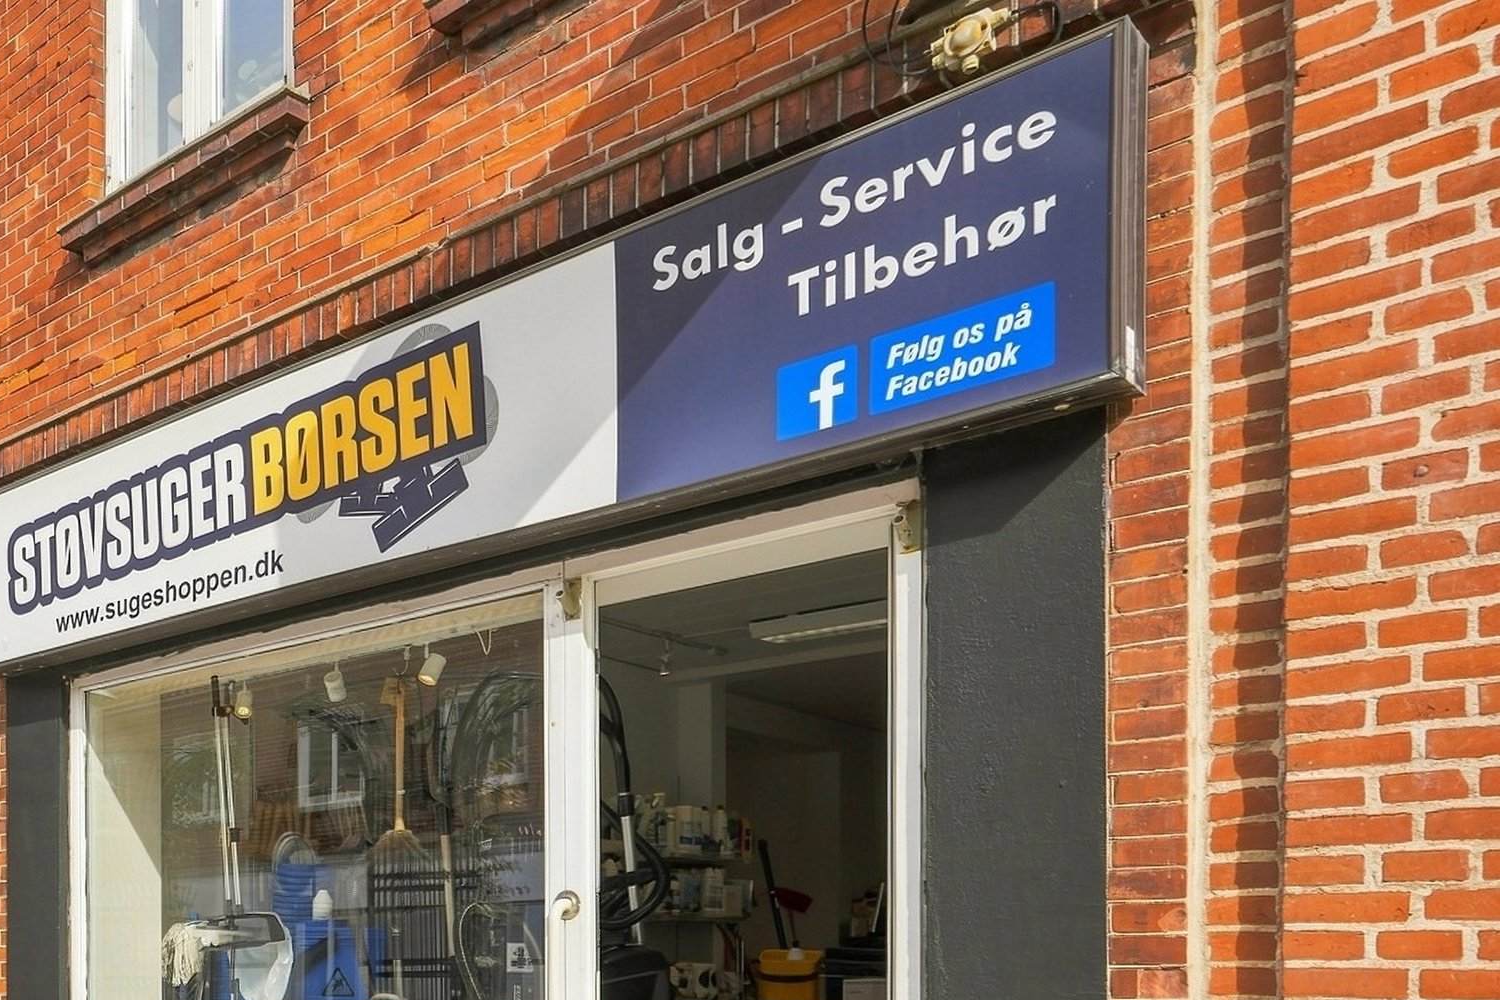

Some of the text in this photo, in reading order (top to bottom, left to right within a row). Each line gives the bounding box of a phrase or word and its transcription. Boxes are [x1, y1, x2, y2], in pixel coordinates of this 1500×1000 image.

[651, 221, 765, 292] Salg
[818, 109, 1058, 229] Service
[787, 194, 1058, 317] Tilbehør
[885, 341, 1022, 402] Facebook
[886, 302, 1033, 370] Følg os på
[808, 359, 846, 431] f
[55, 549, 285, 634] www.sugeshoppen.dk
